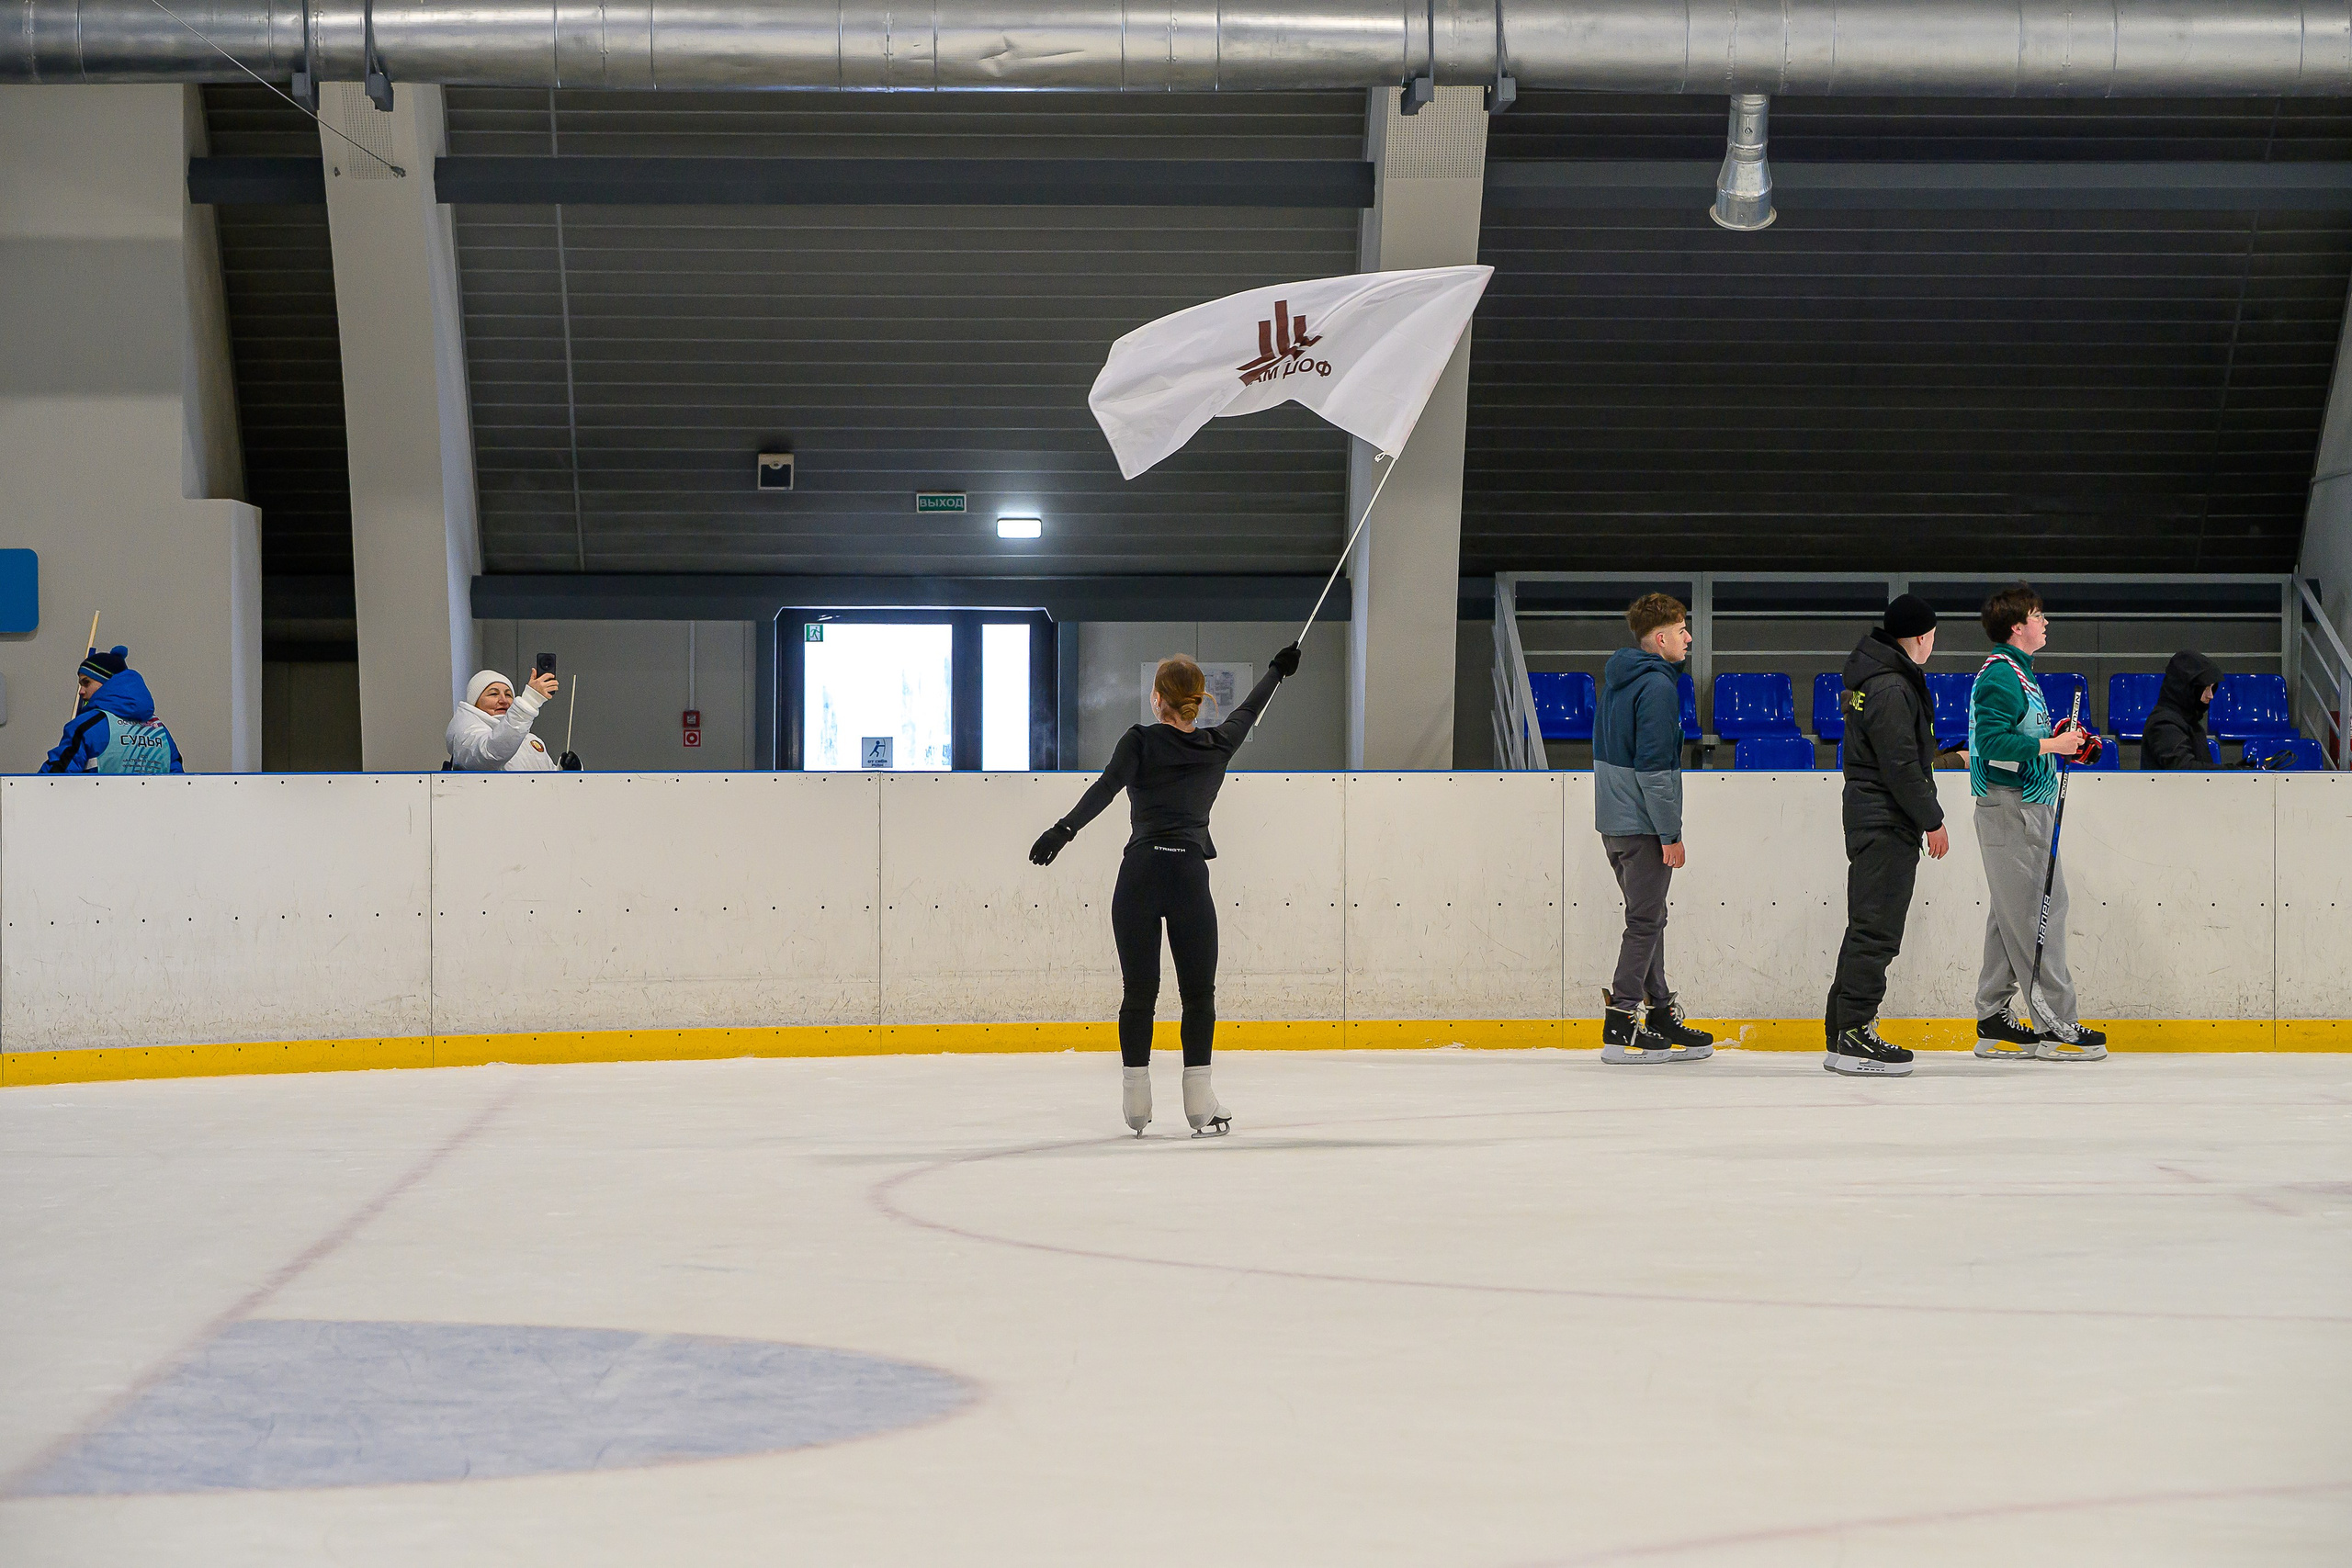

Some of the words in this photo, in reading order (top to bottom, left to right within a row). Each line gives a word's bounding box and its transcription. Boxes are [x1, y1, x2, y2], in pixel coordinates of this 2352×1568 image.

[919, 498, 964, 509] ВЫХОД
[2071, 694, 2080, 728] NEXUS
[120, 734, 163, 748] СУДЬЯ
